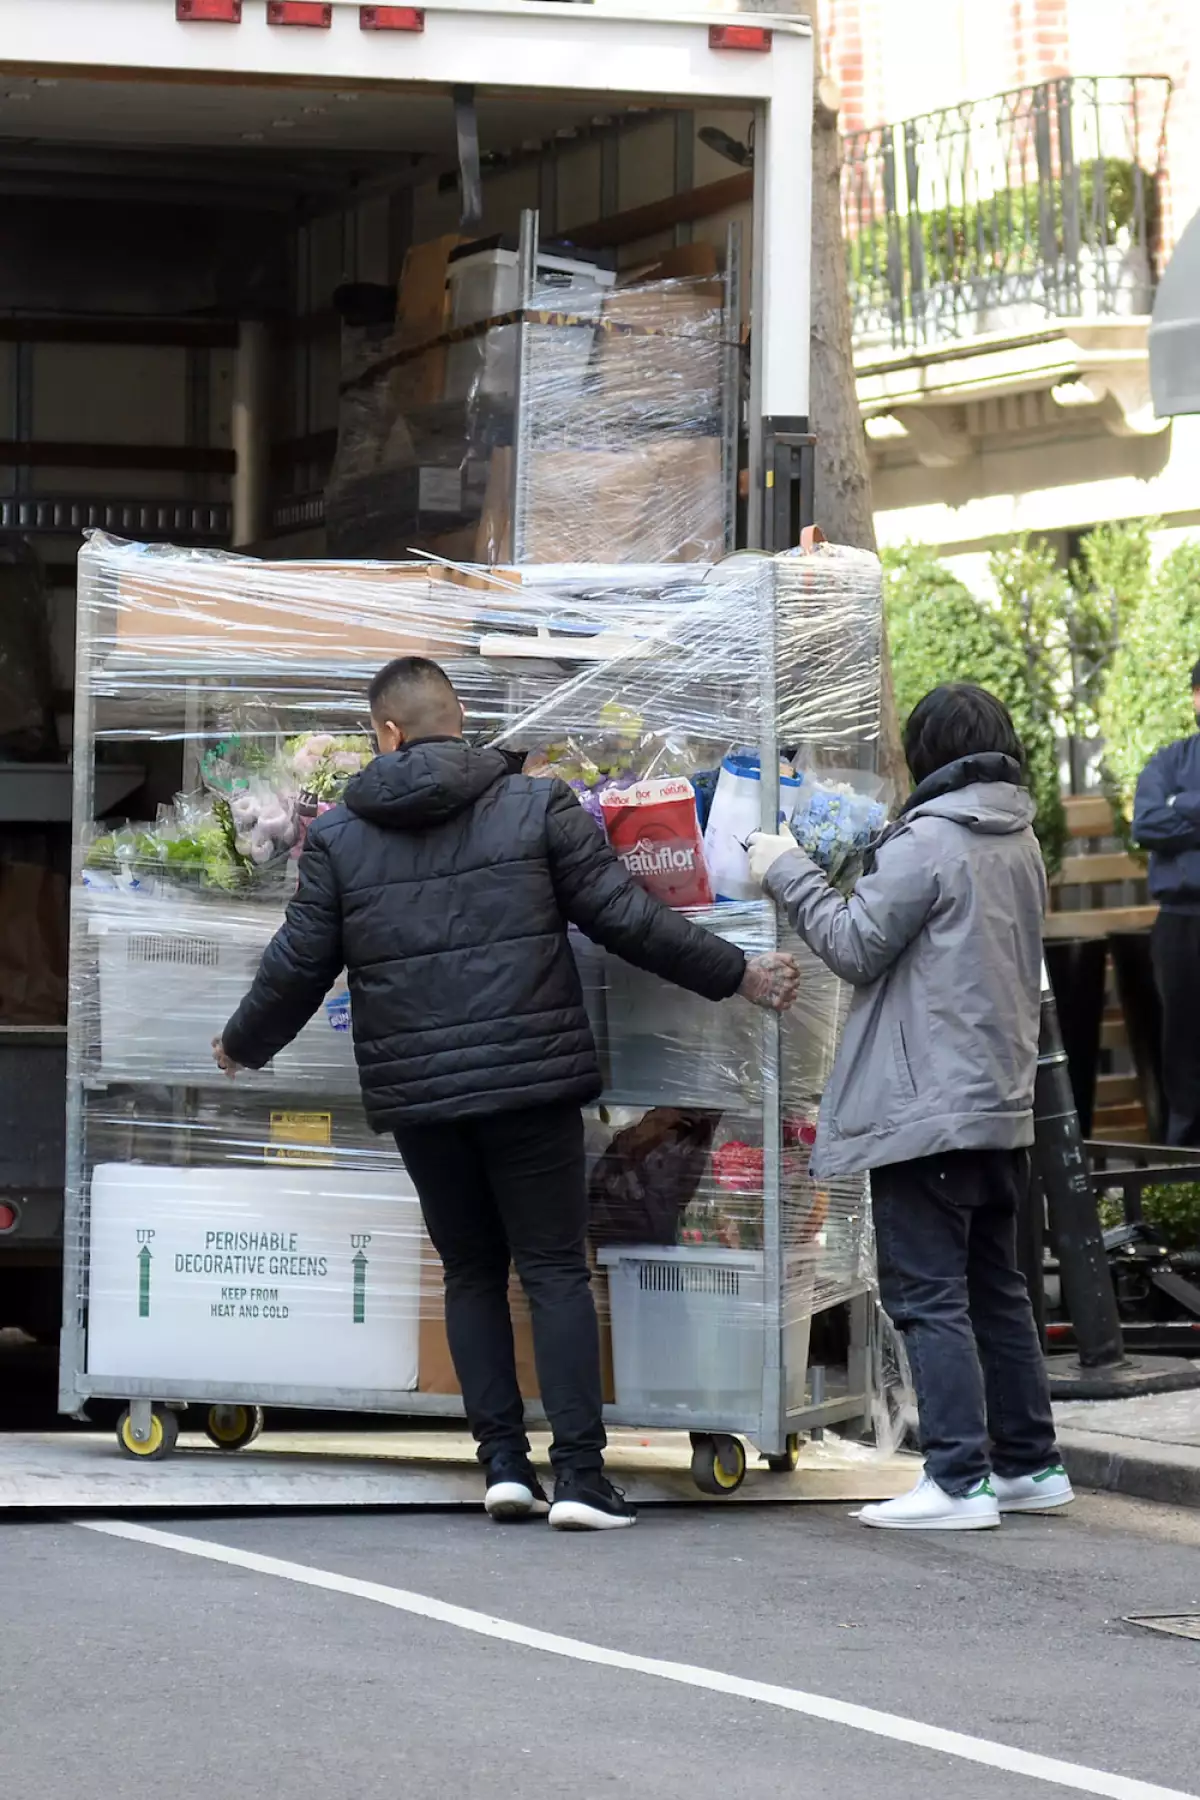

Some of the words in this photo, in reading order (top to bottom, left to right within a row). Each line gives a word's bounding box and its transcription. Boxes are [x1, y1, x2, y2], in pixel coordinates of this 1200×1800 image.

[136, 1229, 156, 1244] UP
[205, 1231, 298, 1252] PERISHABLE
[350, 1234, 371, 1249] UP
[174, 1254, 265, 1275] DECORATIVE
[269, 1256, 328, 1277] GREENS
[221, 1288, 247, 1300] KEEP
[250, 1288, 279, 1301] FROM
[210, 1304, 235, 1317] HEAT
[239, 1305, 259, 1317] AND
[262, 1305, 289, 1319] COLD
